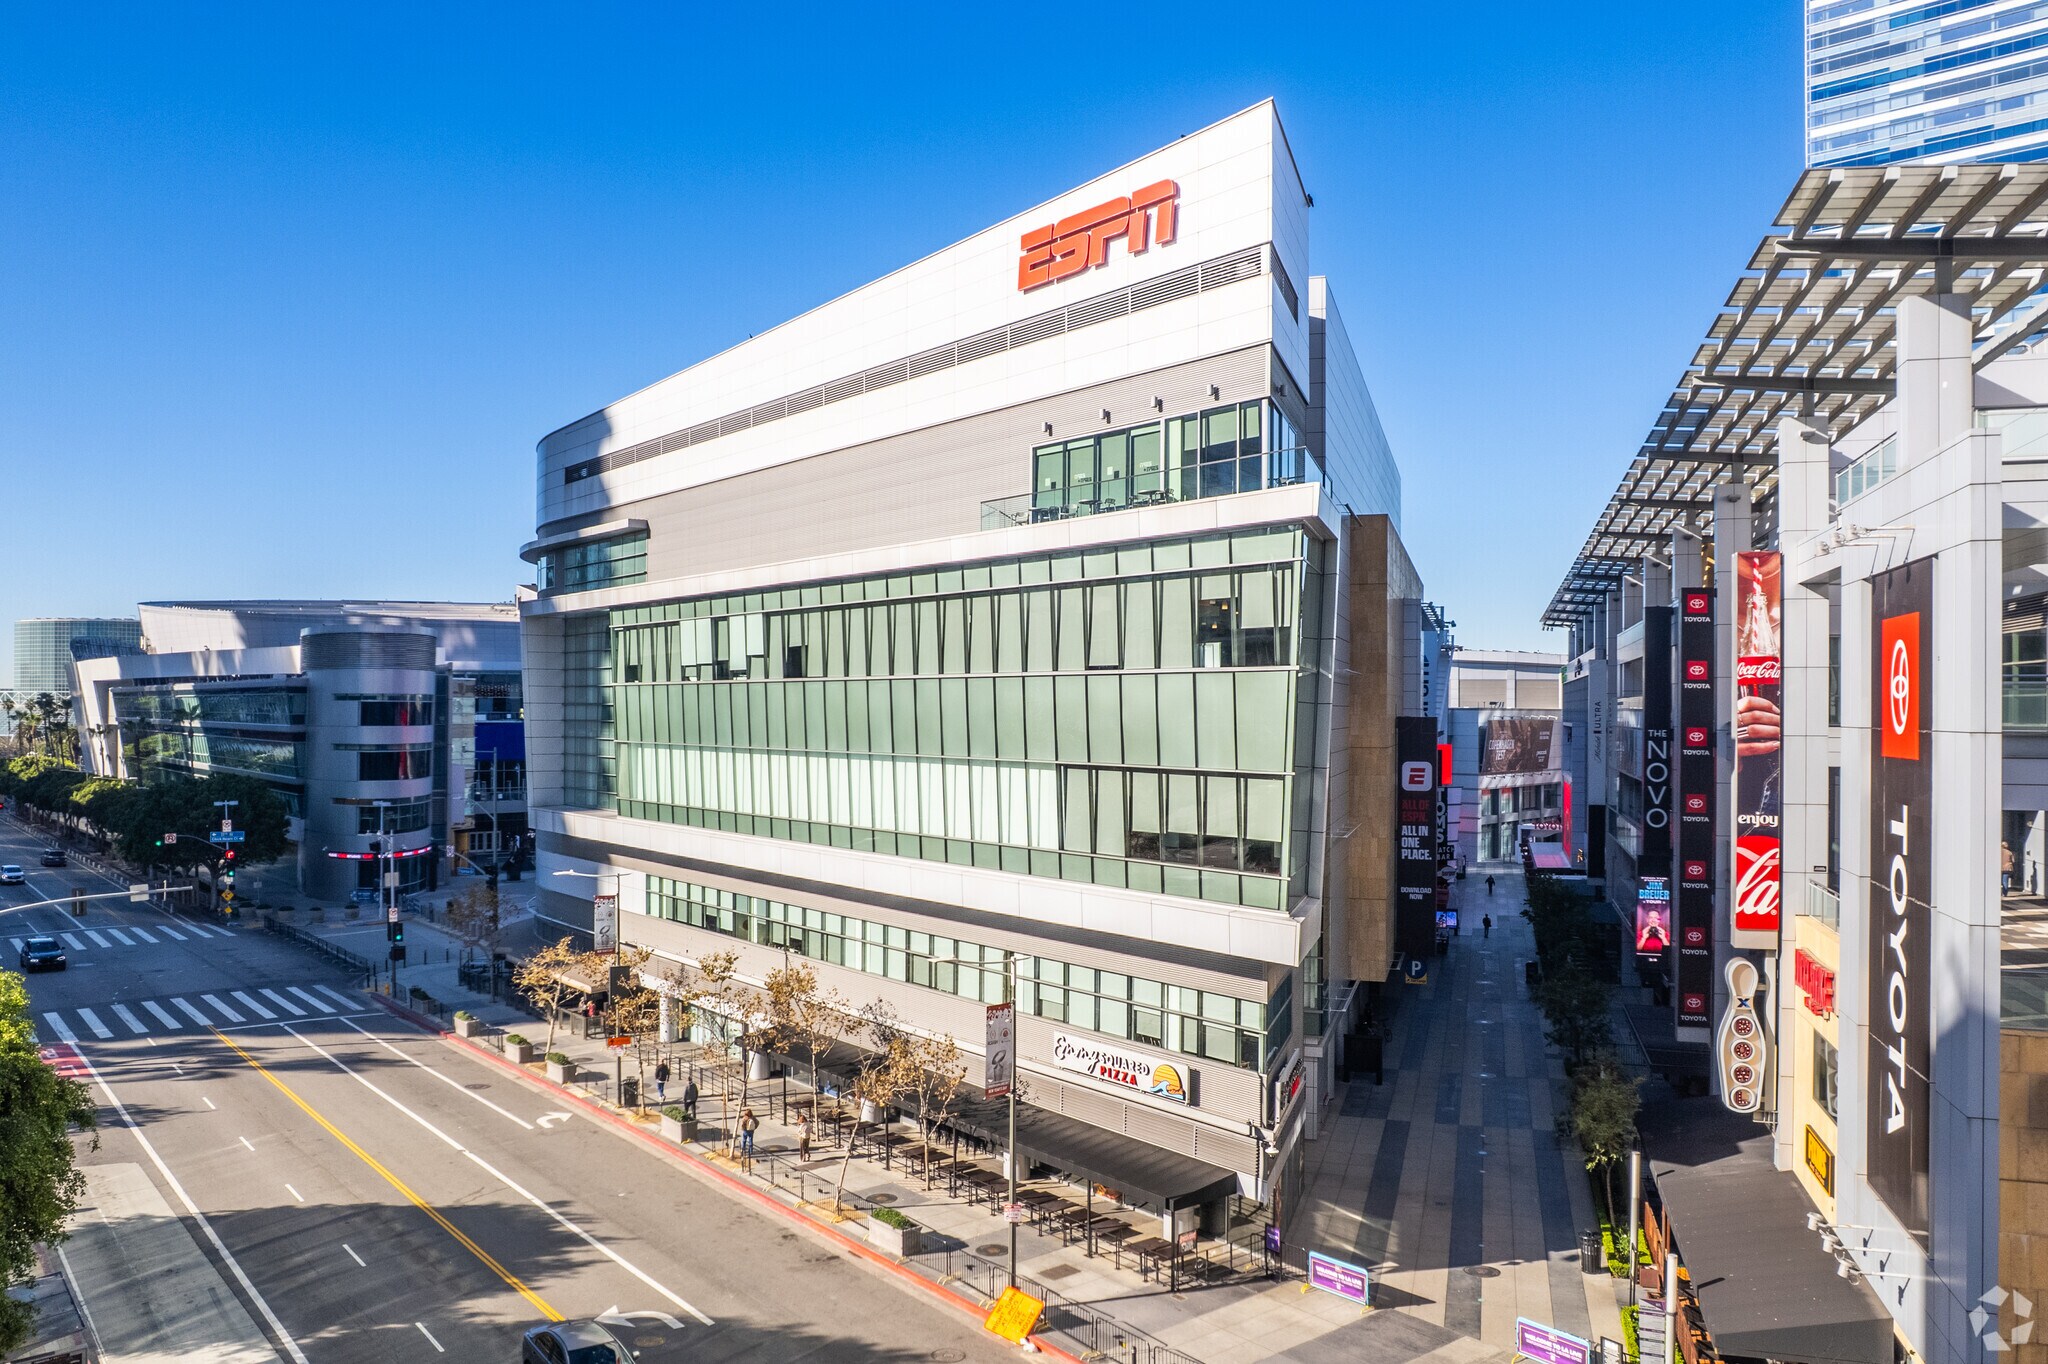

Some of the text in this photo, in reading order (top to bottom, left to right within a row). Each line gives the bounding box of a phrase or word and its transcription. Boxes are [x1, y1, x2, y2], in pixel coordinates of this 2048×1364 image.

[1018, 179, 1176, 292] ESPN
[1737, 661, 1780, 679] Coca-Cola
[1648, 729, 1667, 738] THE
[1646, 741, 1668, 828] NOVO
[1402, 800, 1417, 810] ALL
[1532, 822, 1562, 830] TOYOT
[1738, 812, 1778, 828] enjoy
[1402, 825, 1428, 836] ALL IN
[1402, 838, 1420, 848] ONE
[1402, 849, 1432, 860] PLACE.
[1646, 882, 1662, 890] JIM
[1639, 890, 1670, 900] BREUER
[1412, 960, 1422, 976] P
[1888, 804, 1909, 1135] TOYOTA
[1055, 1036, 1150, 1076] Emmy SQUARED
[1100, 1065, 1138, 1087] PIZZA
